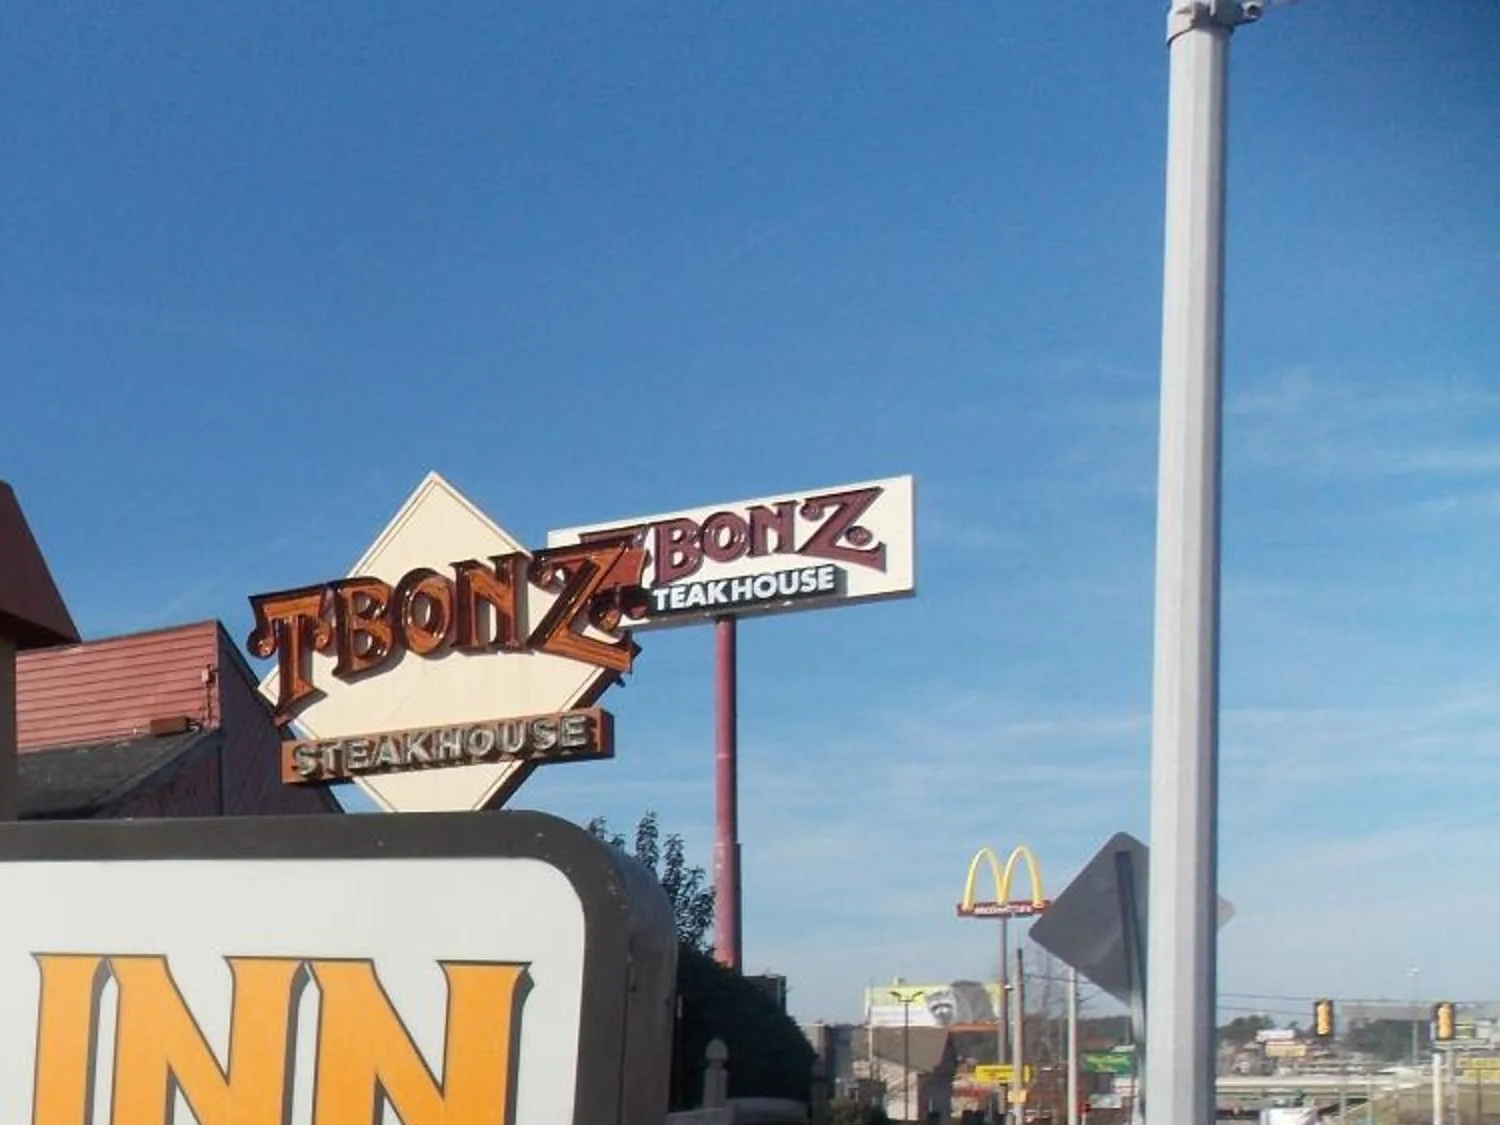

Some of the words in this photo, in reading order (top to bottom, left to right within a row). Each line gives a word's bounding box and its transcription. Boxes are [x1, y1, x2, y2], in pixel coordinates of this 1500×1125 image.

[650, 566, 834, 611] TEAKHOUSE
[247, 540, 642, 728] TBONZ
[291, 713, 590, 777] STEAKHOUSE
